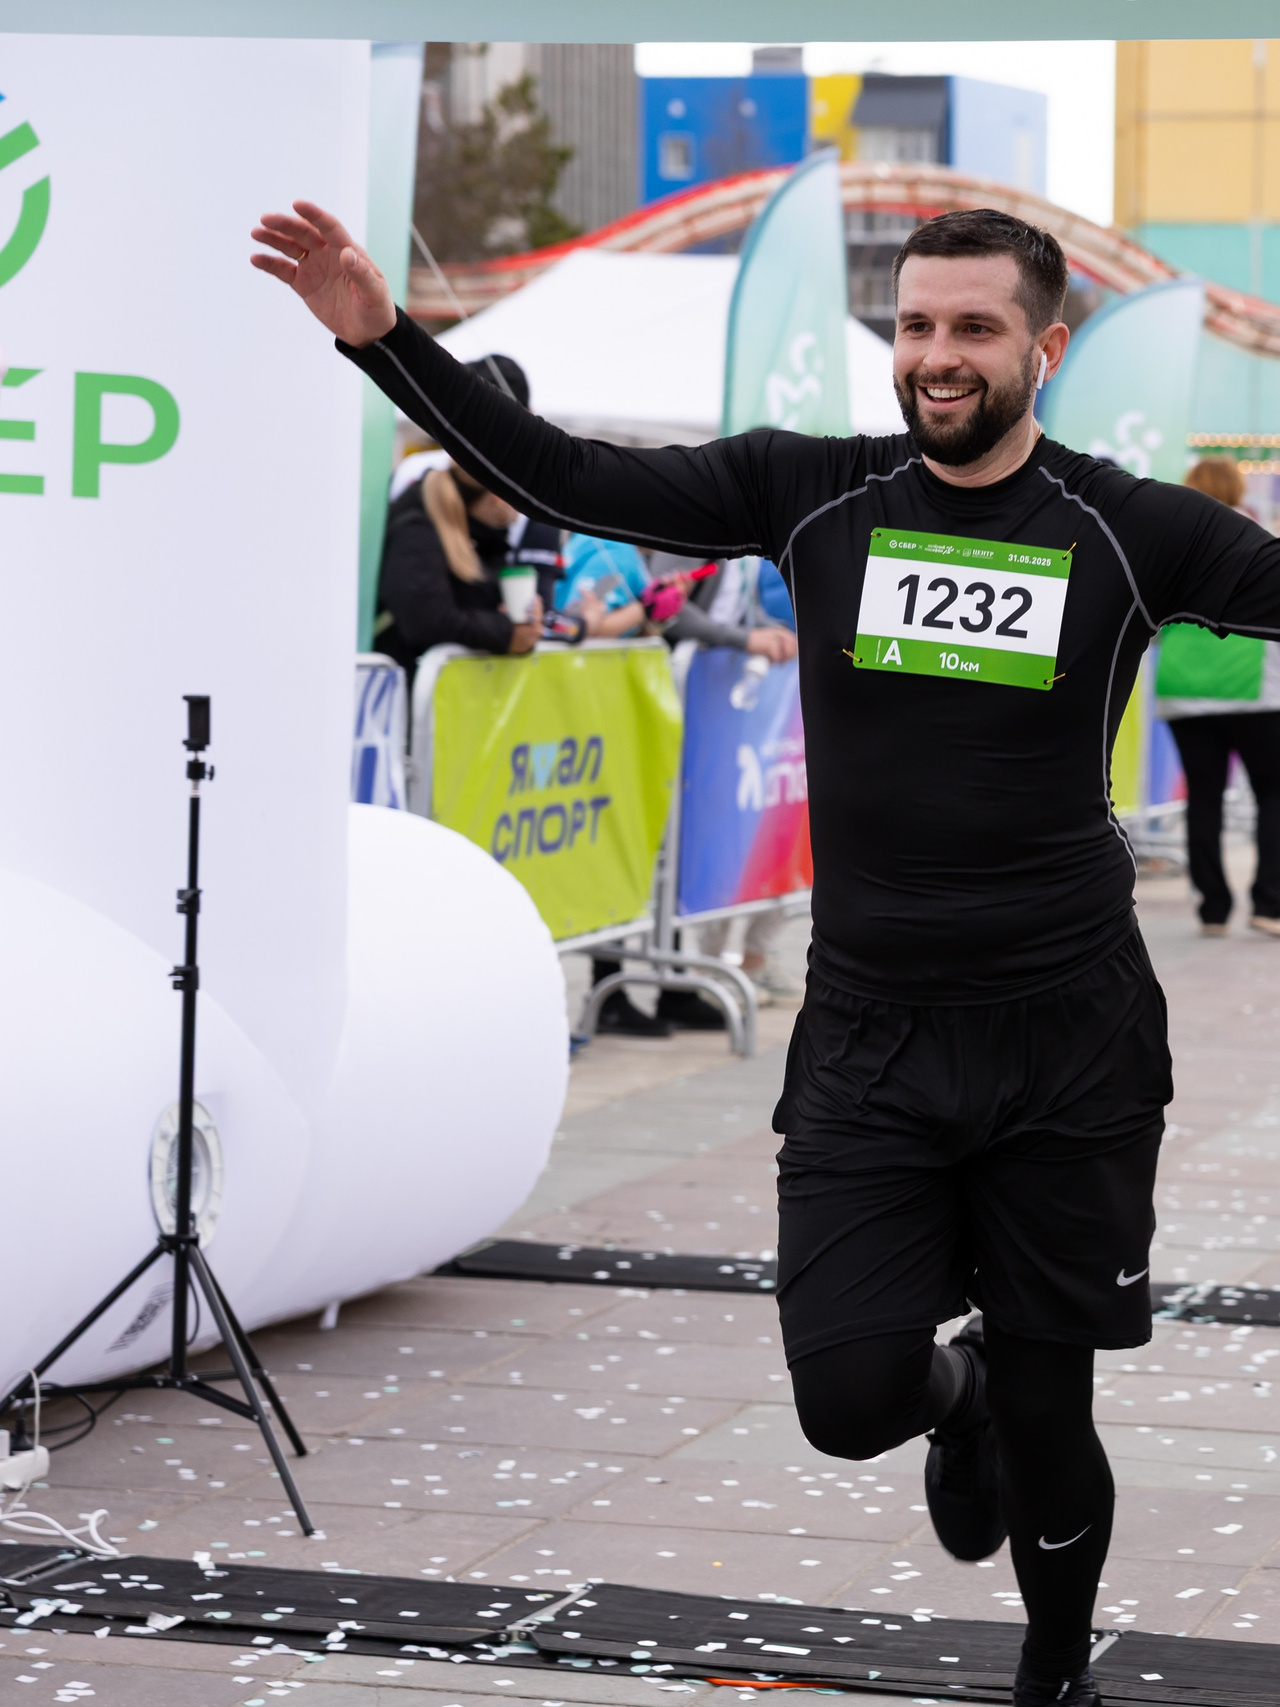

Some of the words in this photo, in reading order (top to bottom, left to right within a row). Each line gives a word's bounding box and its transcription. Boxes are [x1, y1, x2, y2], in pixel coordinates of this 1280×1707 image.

[898, 541, 917, 550] СБЕР
[1008, 553, 1052, 567] 31.05.2025
[897, 573, 1034, 639] 1232
